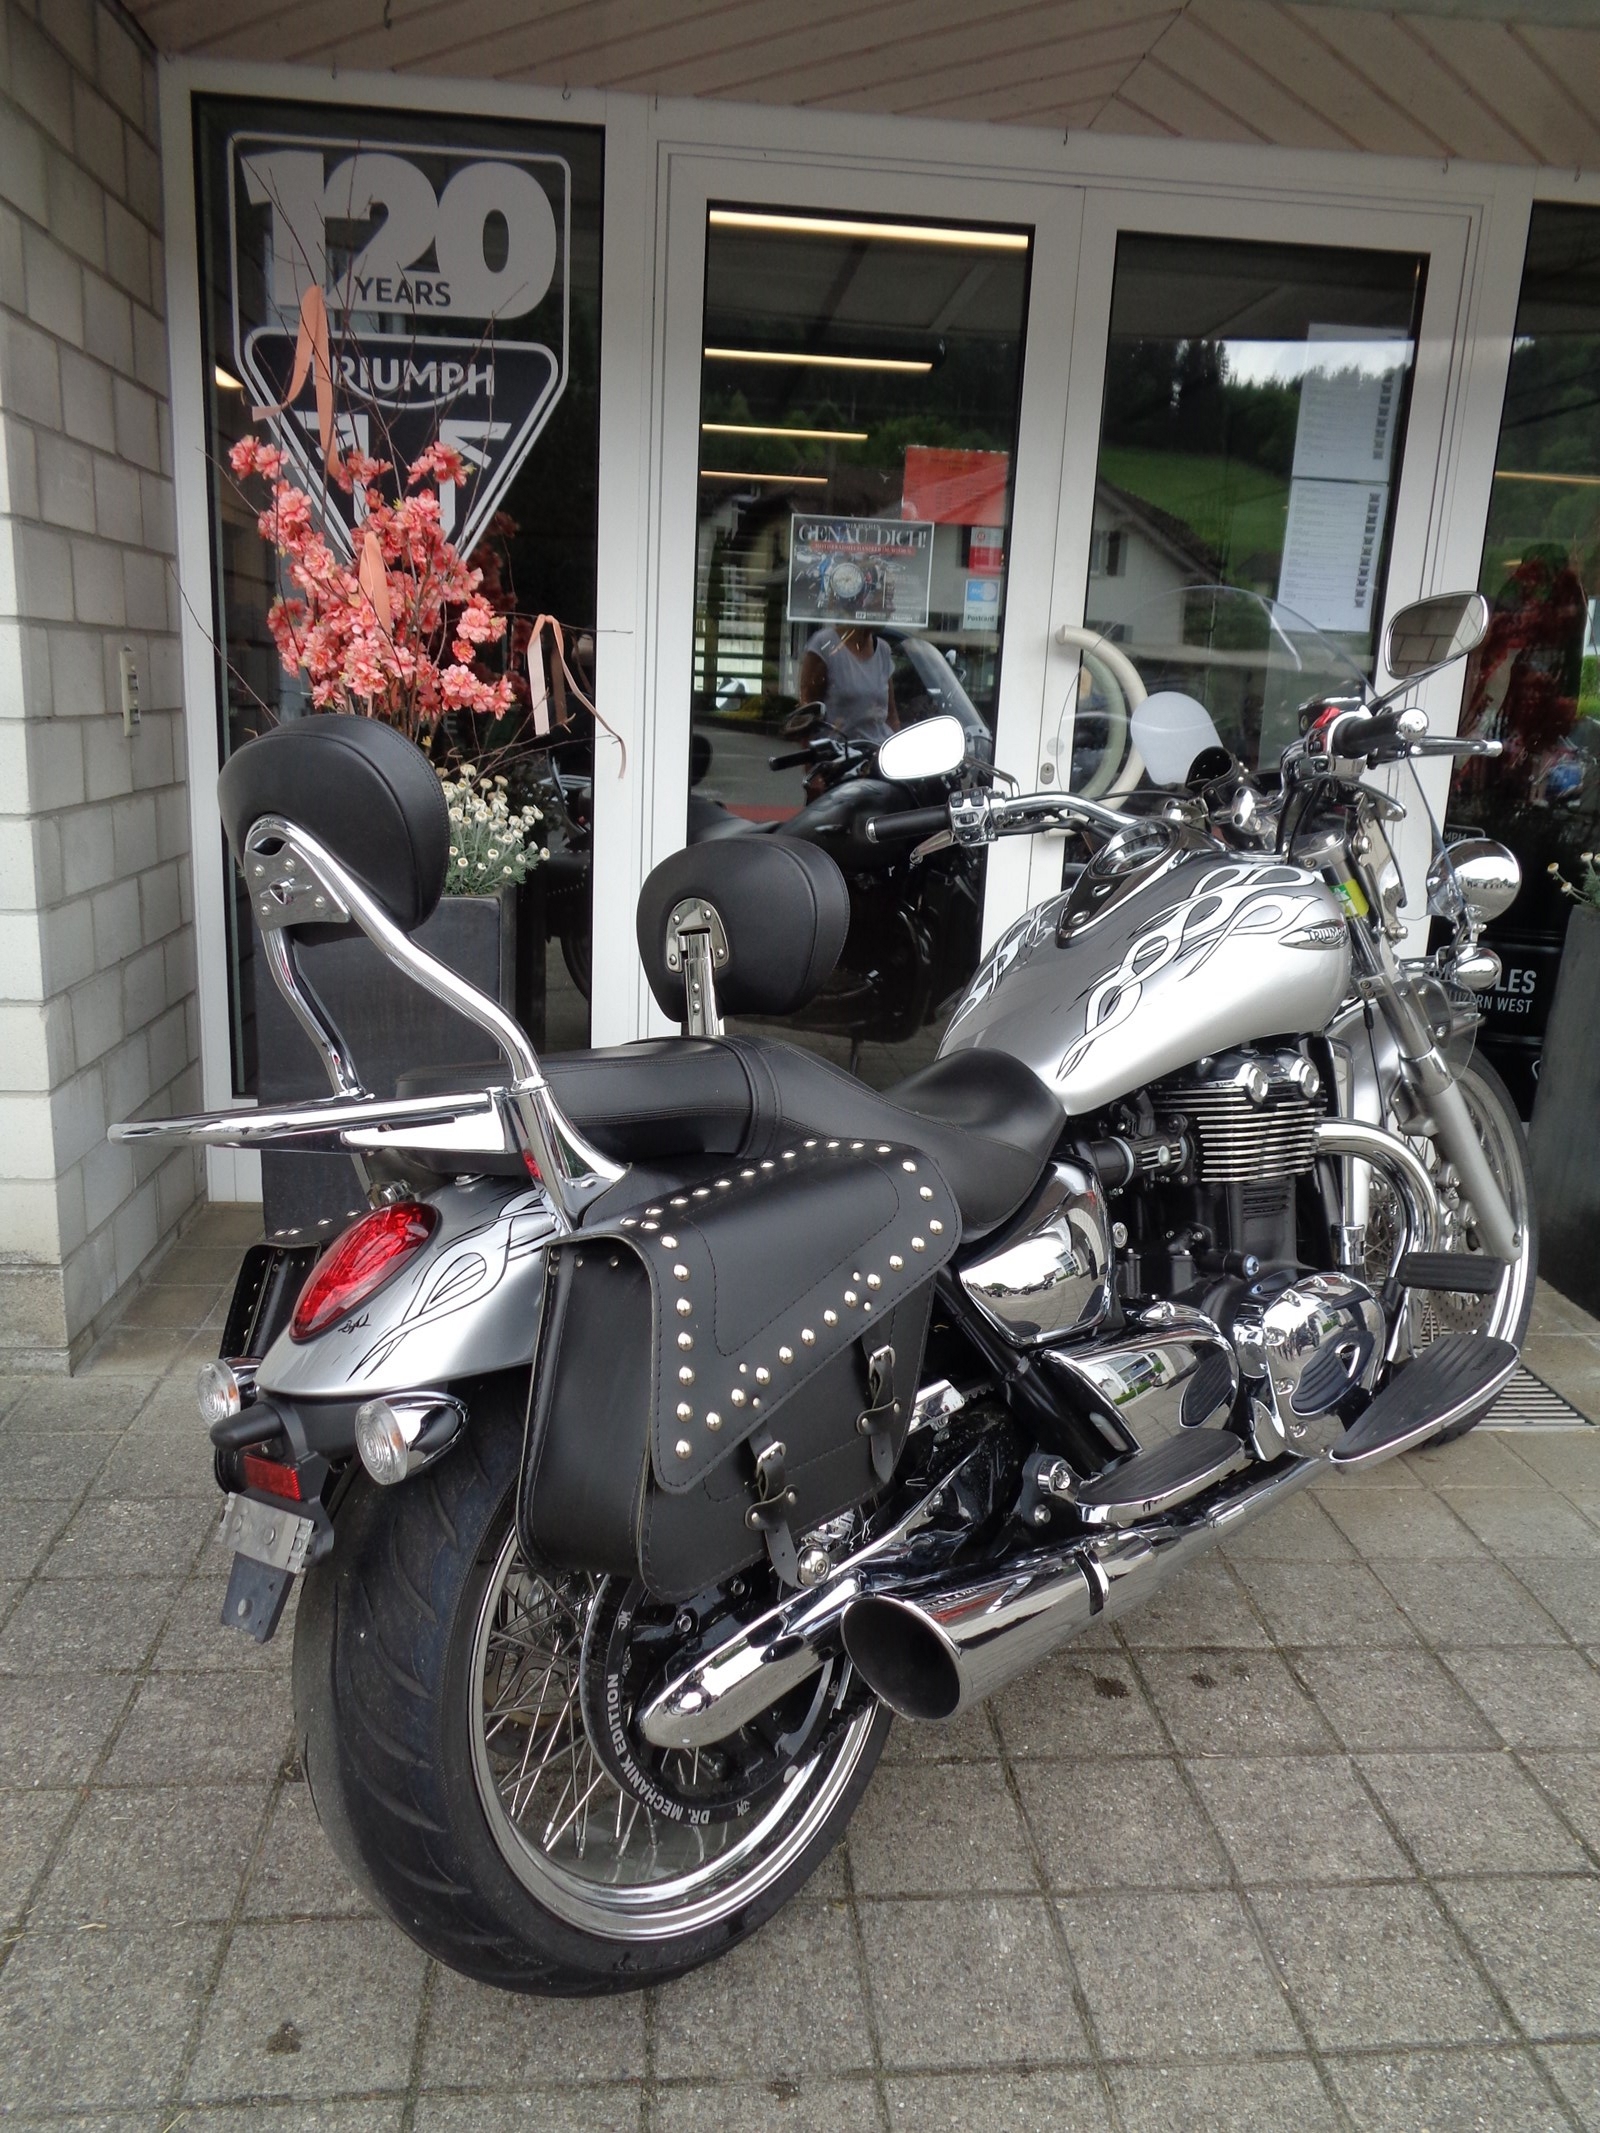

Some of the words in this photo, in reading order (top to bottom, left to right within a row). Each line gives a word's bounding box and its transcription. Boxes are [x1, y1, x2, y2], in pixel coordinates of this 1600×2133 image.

[240, 150, 556, 319] 120
[354, 275, 452, 307] YEARS
[798, 523, 869, 546] GENAU
[876, 529, 927, 548] DICH!
[1497, 997, 1533, 1013] WEST
[606, 1673, 628, 1757] EDITION
[620, 1754, 684, 1821] MECHANIK
[687, 1808, 711, 1825] DR.
